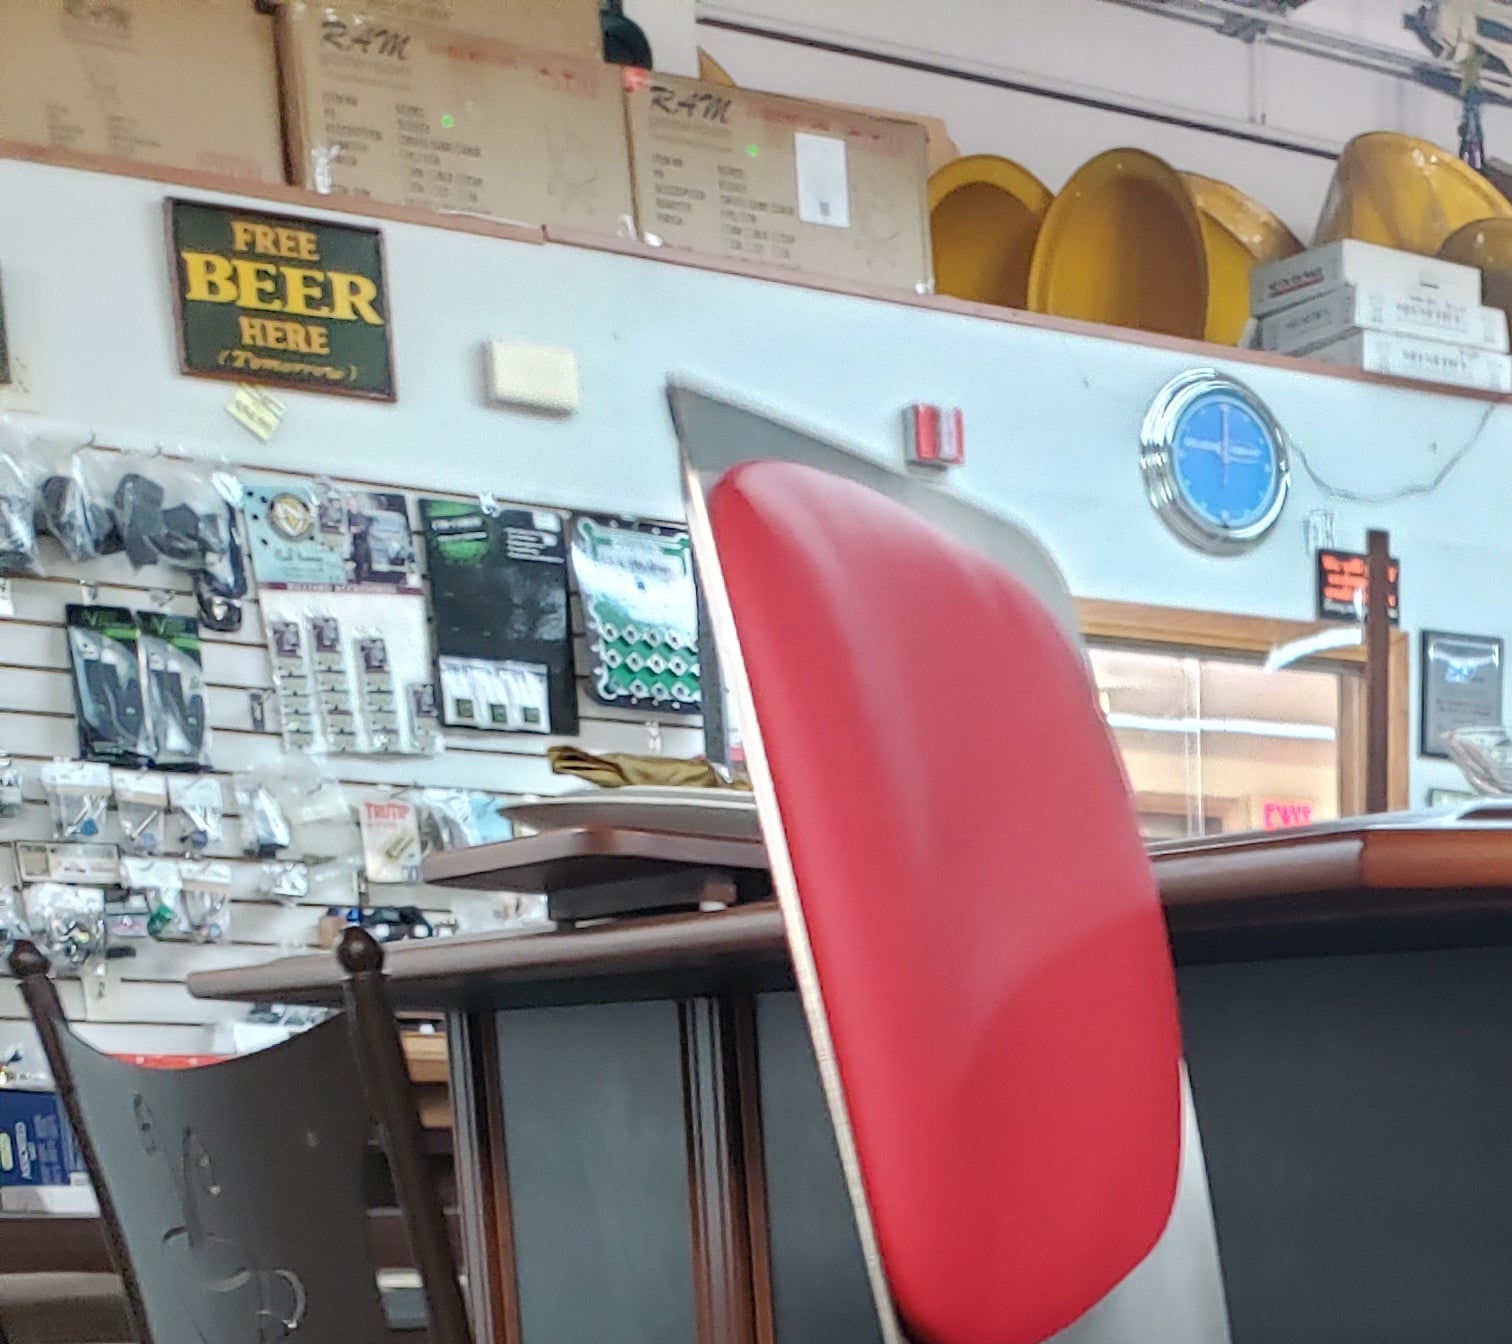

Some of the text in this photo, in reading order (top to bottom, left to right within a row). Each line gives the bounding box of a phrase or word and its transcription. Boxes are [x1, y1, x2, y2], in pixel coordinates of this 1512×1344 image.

[321, 21, 410, 61] RAM
[650, 85, 732, 124] RAM
[231, 220, 320, 261] FREE
[181, 250, 385, 325] BEER
[238, 315, 330, 355] HERE
